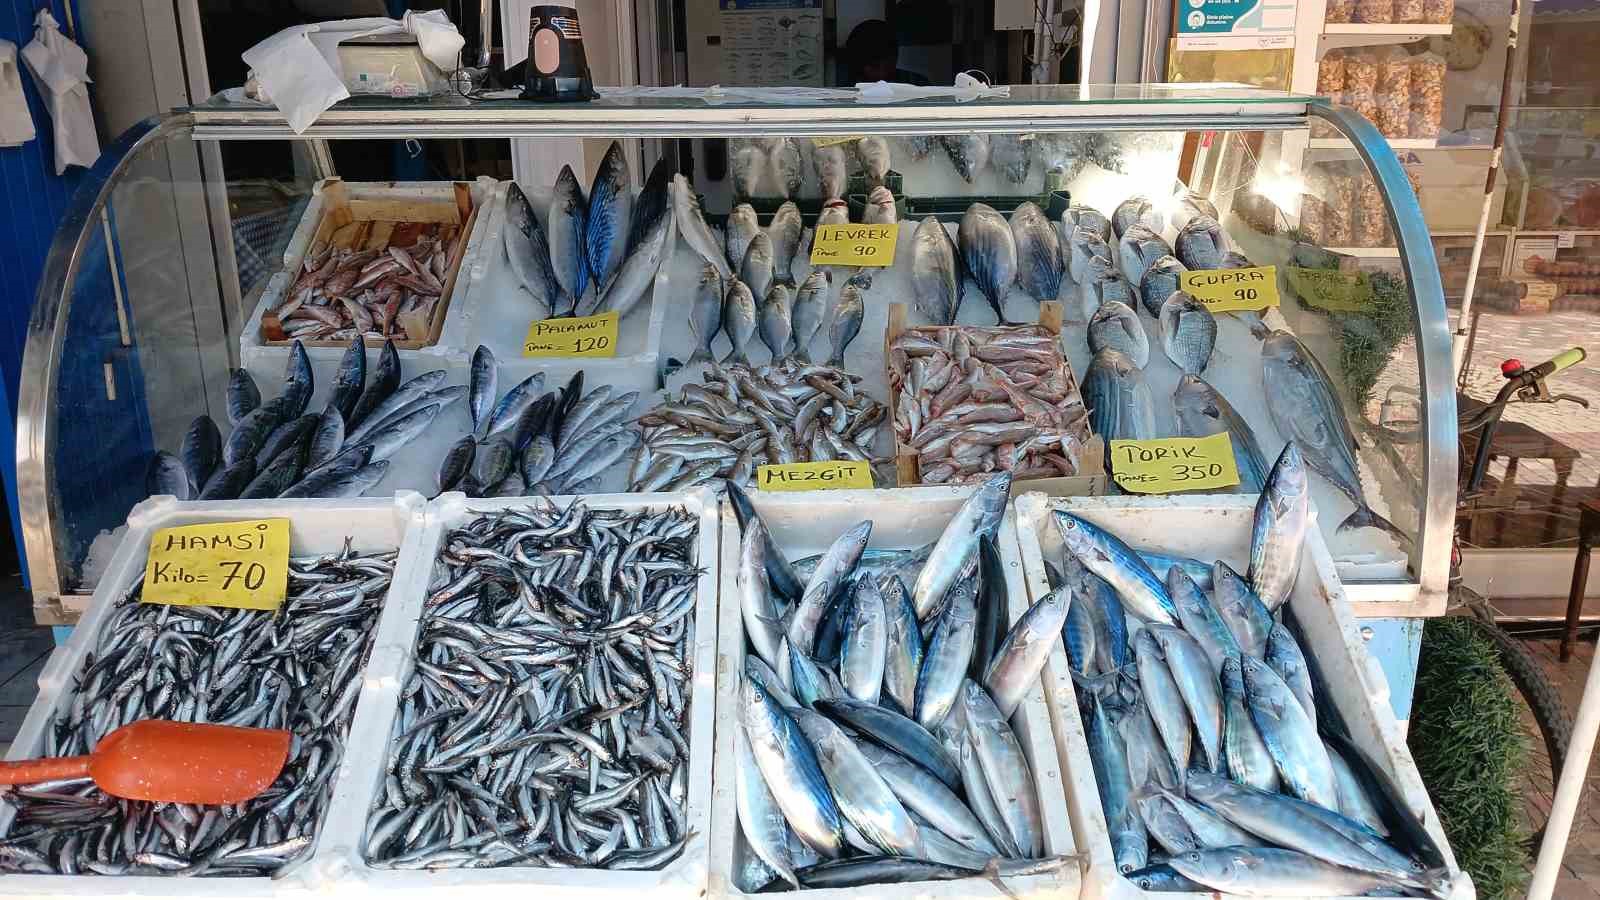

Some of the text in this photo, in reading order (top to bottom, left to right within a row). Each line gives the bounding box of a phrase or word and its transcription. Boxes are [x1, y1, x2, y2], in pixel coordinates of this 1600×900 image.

[822, 229, 889, 241] LEVREK
[854, 245, 877, 256] 90
[1233, 288, 1258, 301] 90
[535, 319, 609, 336] PALAMUT
[573, 336, 609, 353] 120
[1171, 463, 1222, 481] 350
[165, 523, 268, 551] HAMSİ
[219, 561, 266, 590] 70
